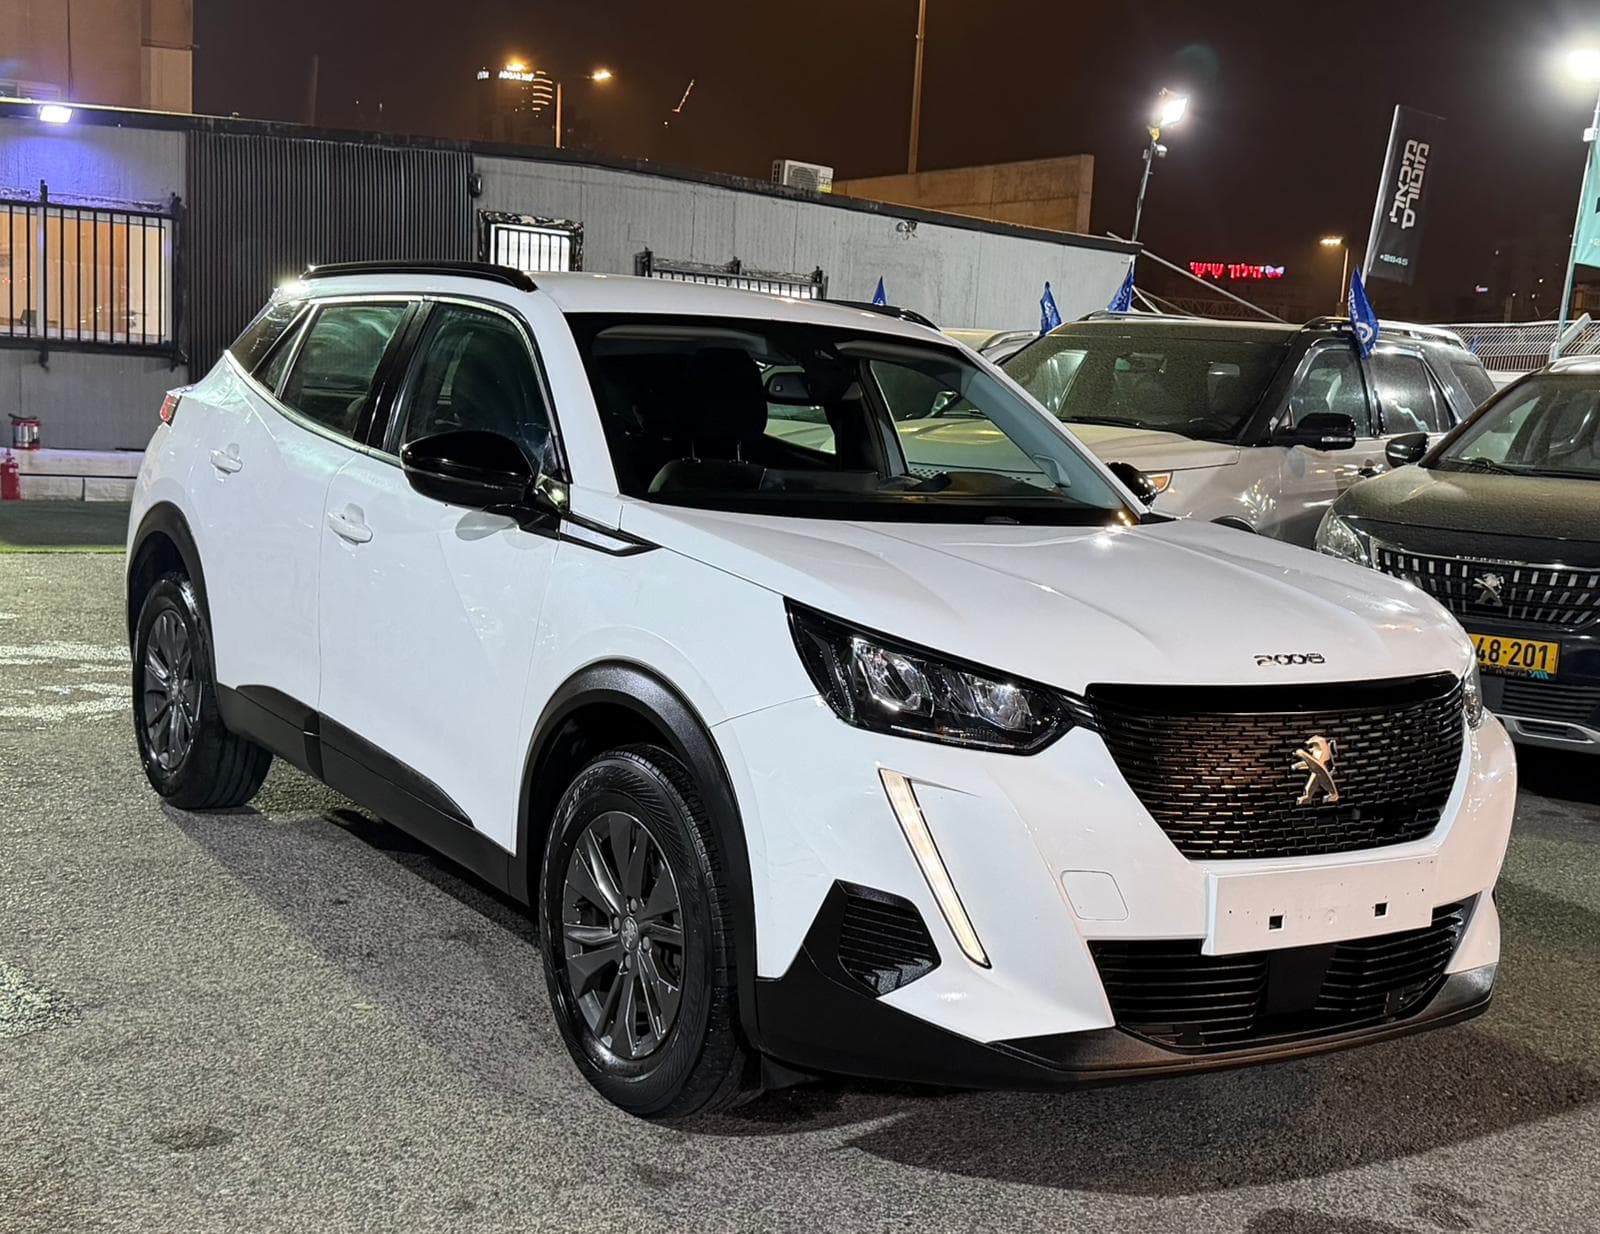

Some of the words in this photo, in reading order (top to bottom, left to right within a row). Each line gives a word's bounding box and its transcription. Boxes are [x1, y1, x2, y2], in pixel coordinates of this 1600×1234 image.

[1389, 139, 1418, 223] מיכאלי
[1401, 142, 1430, 229] מוטורס
[1253, 652, 1326, 667] 2008
